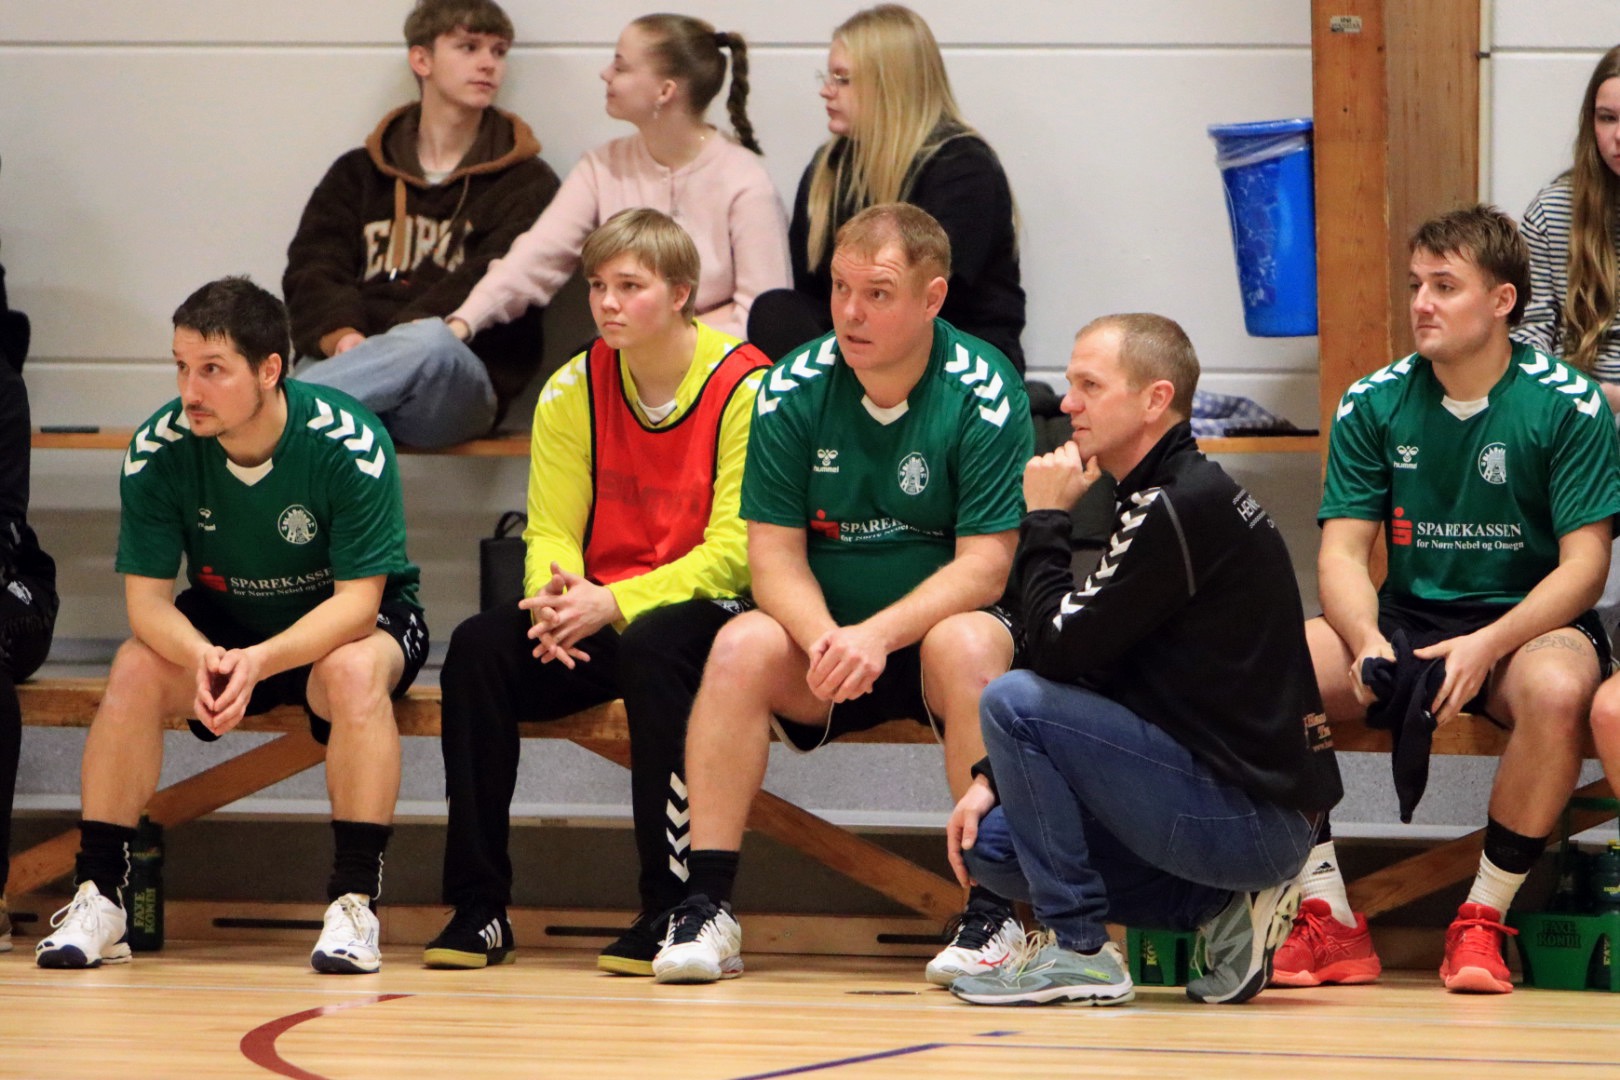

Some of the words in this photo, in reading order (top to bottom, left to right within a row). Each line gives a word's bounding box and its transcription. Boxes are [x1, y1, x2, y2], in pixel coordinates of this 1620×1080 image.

[1417, 521, 1522, 537] SPAREKASSEN
[1416, 539, 1429, 549] for
[1454, 540, 1480, 550] Nebel
[1482, 542, 1492, 551] og
